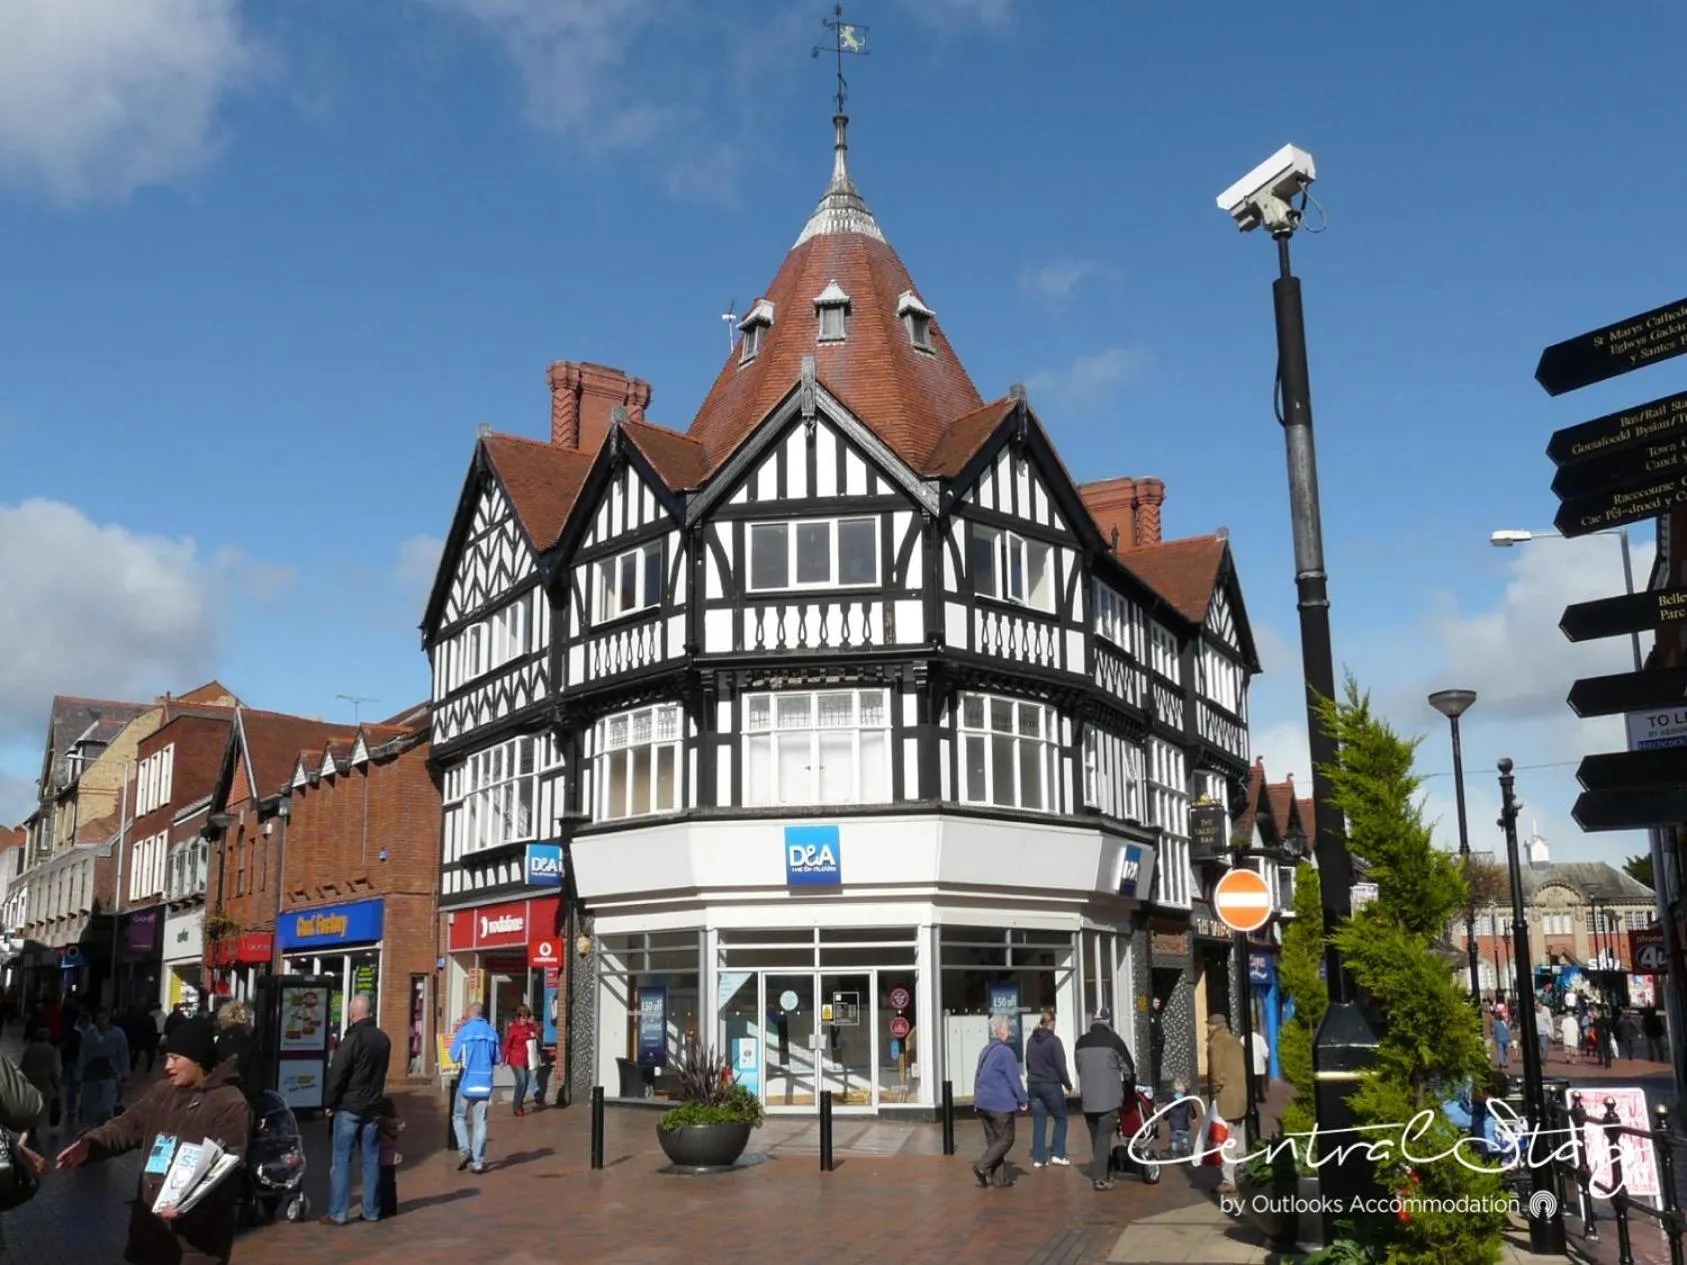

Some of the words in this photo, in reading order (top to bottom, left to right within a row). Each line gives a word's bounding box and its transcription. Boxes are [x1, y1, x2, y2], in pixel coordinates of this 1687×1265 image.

[1613, 481, 1675, 505] Racecourse
[1646, 713, 1670, 730] TO
[788, 843, 837, 867] D&A
